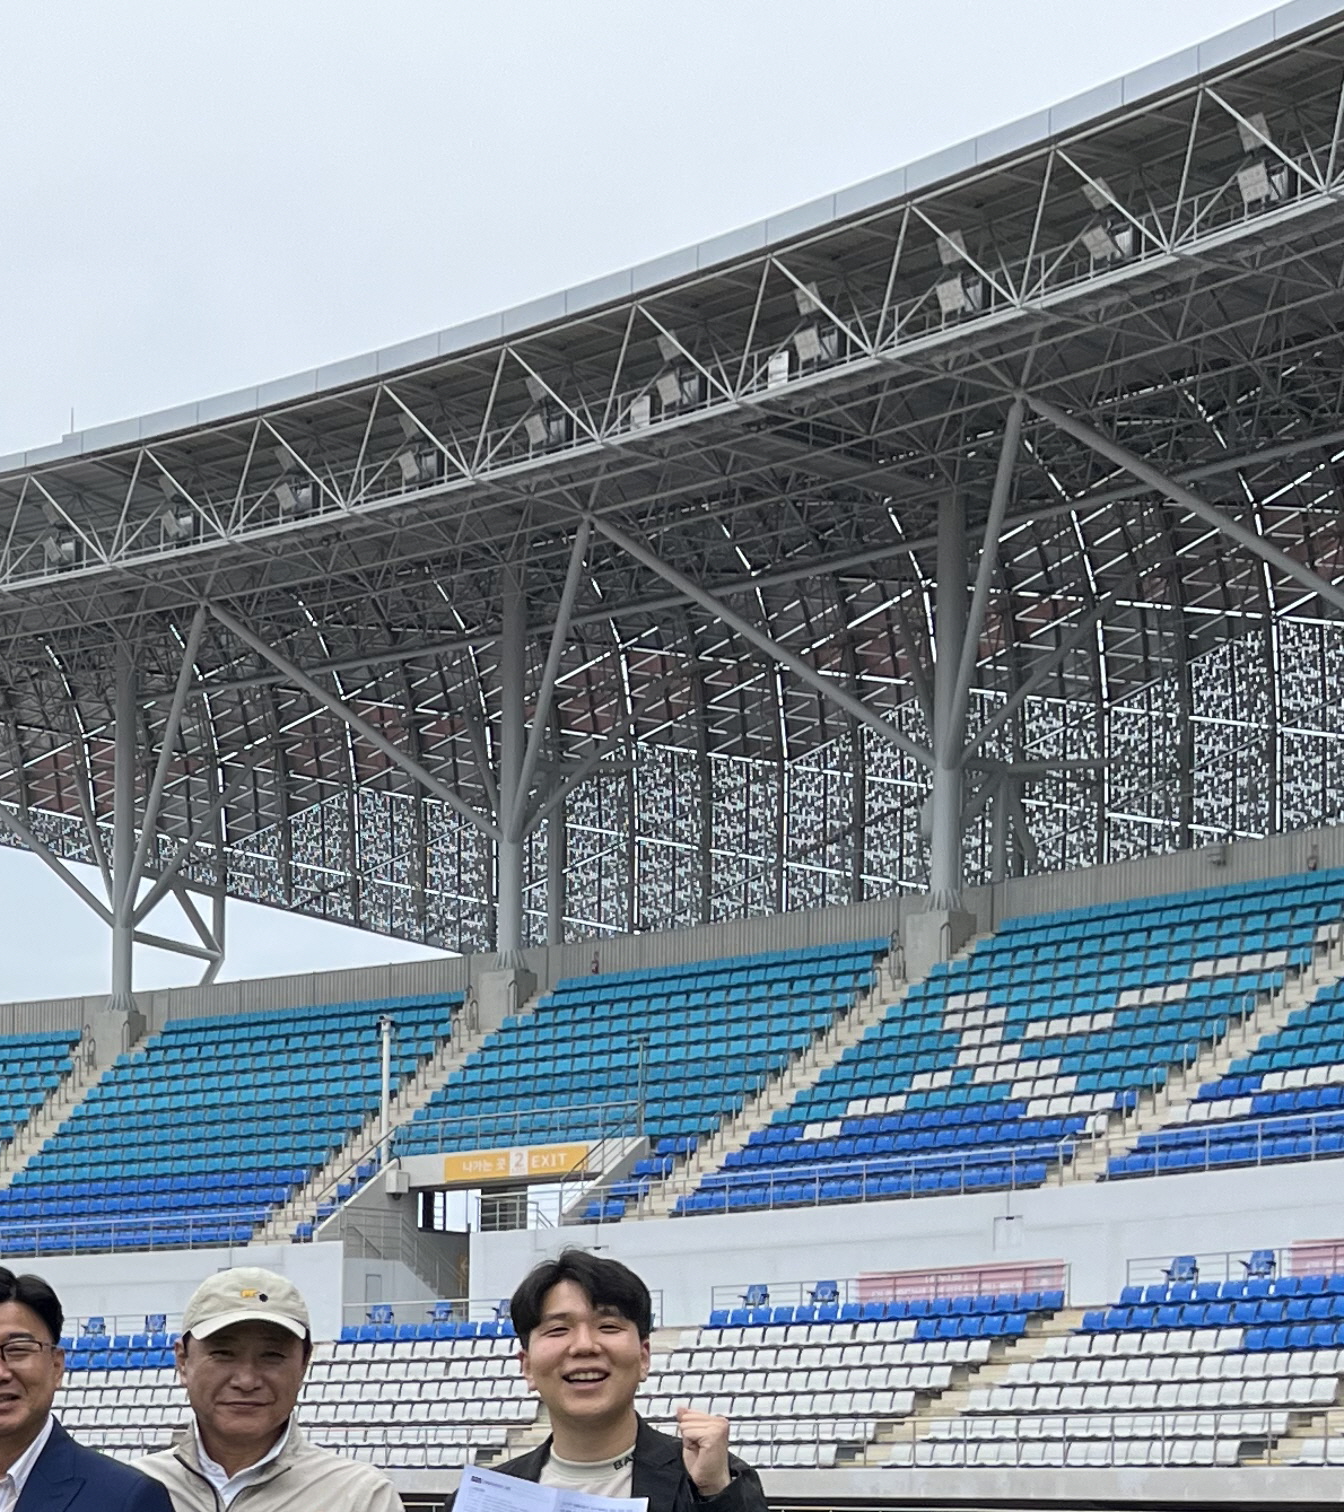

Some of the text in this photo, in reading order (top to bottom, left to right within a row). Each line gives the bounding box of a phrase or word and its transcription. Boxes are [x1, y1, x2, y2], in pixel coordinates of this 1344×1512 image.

[463, 1159, 494, 1172] 나가는
[514, 1152, 524, 1168] 2
[531, 1153, 568, 1168] EXIT
